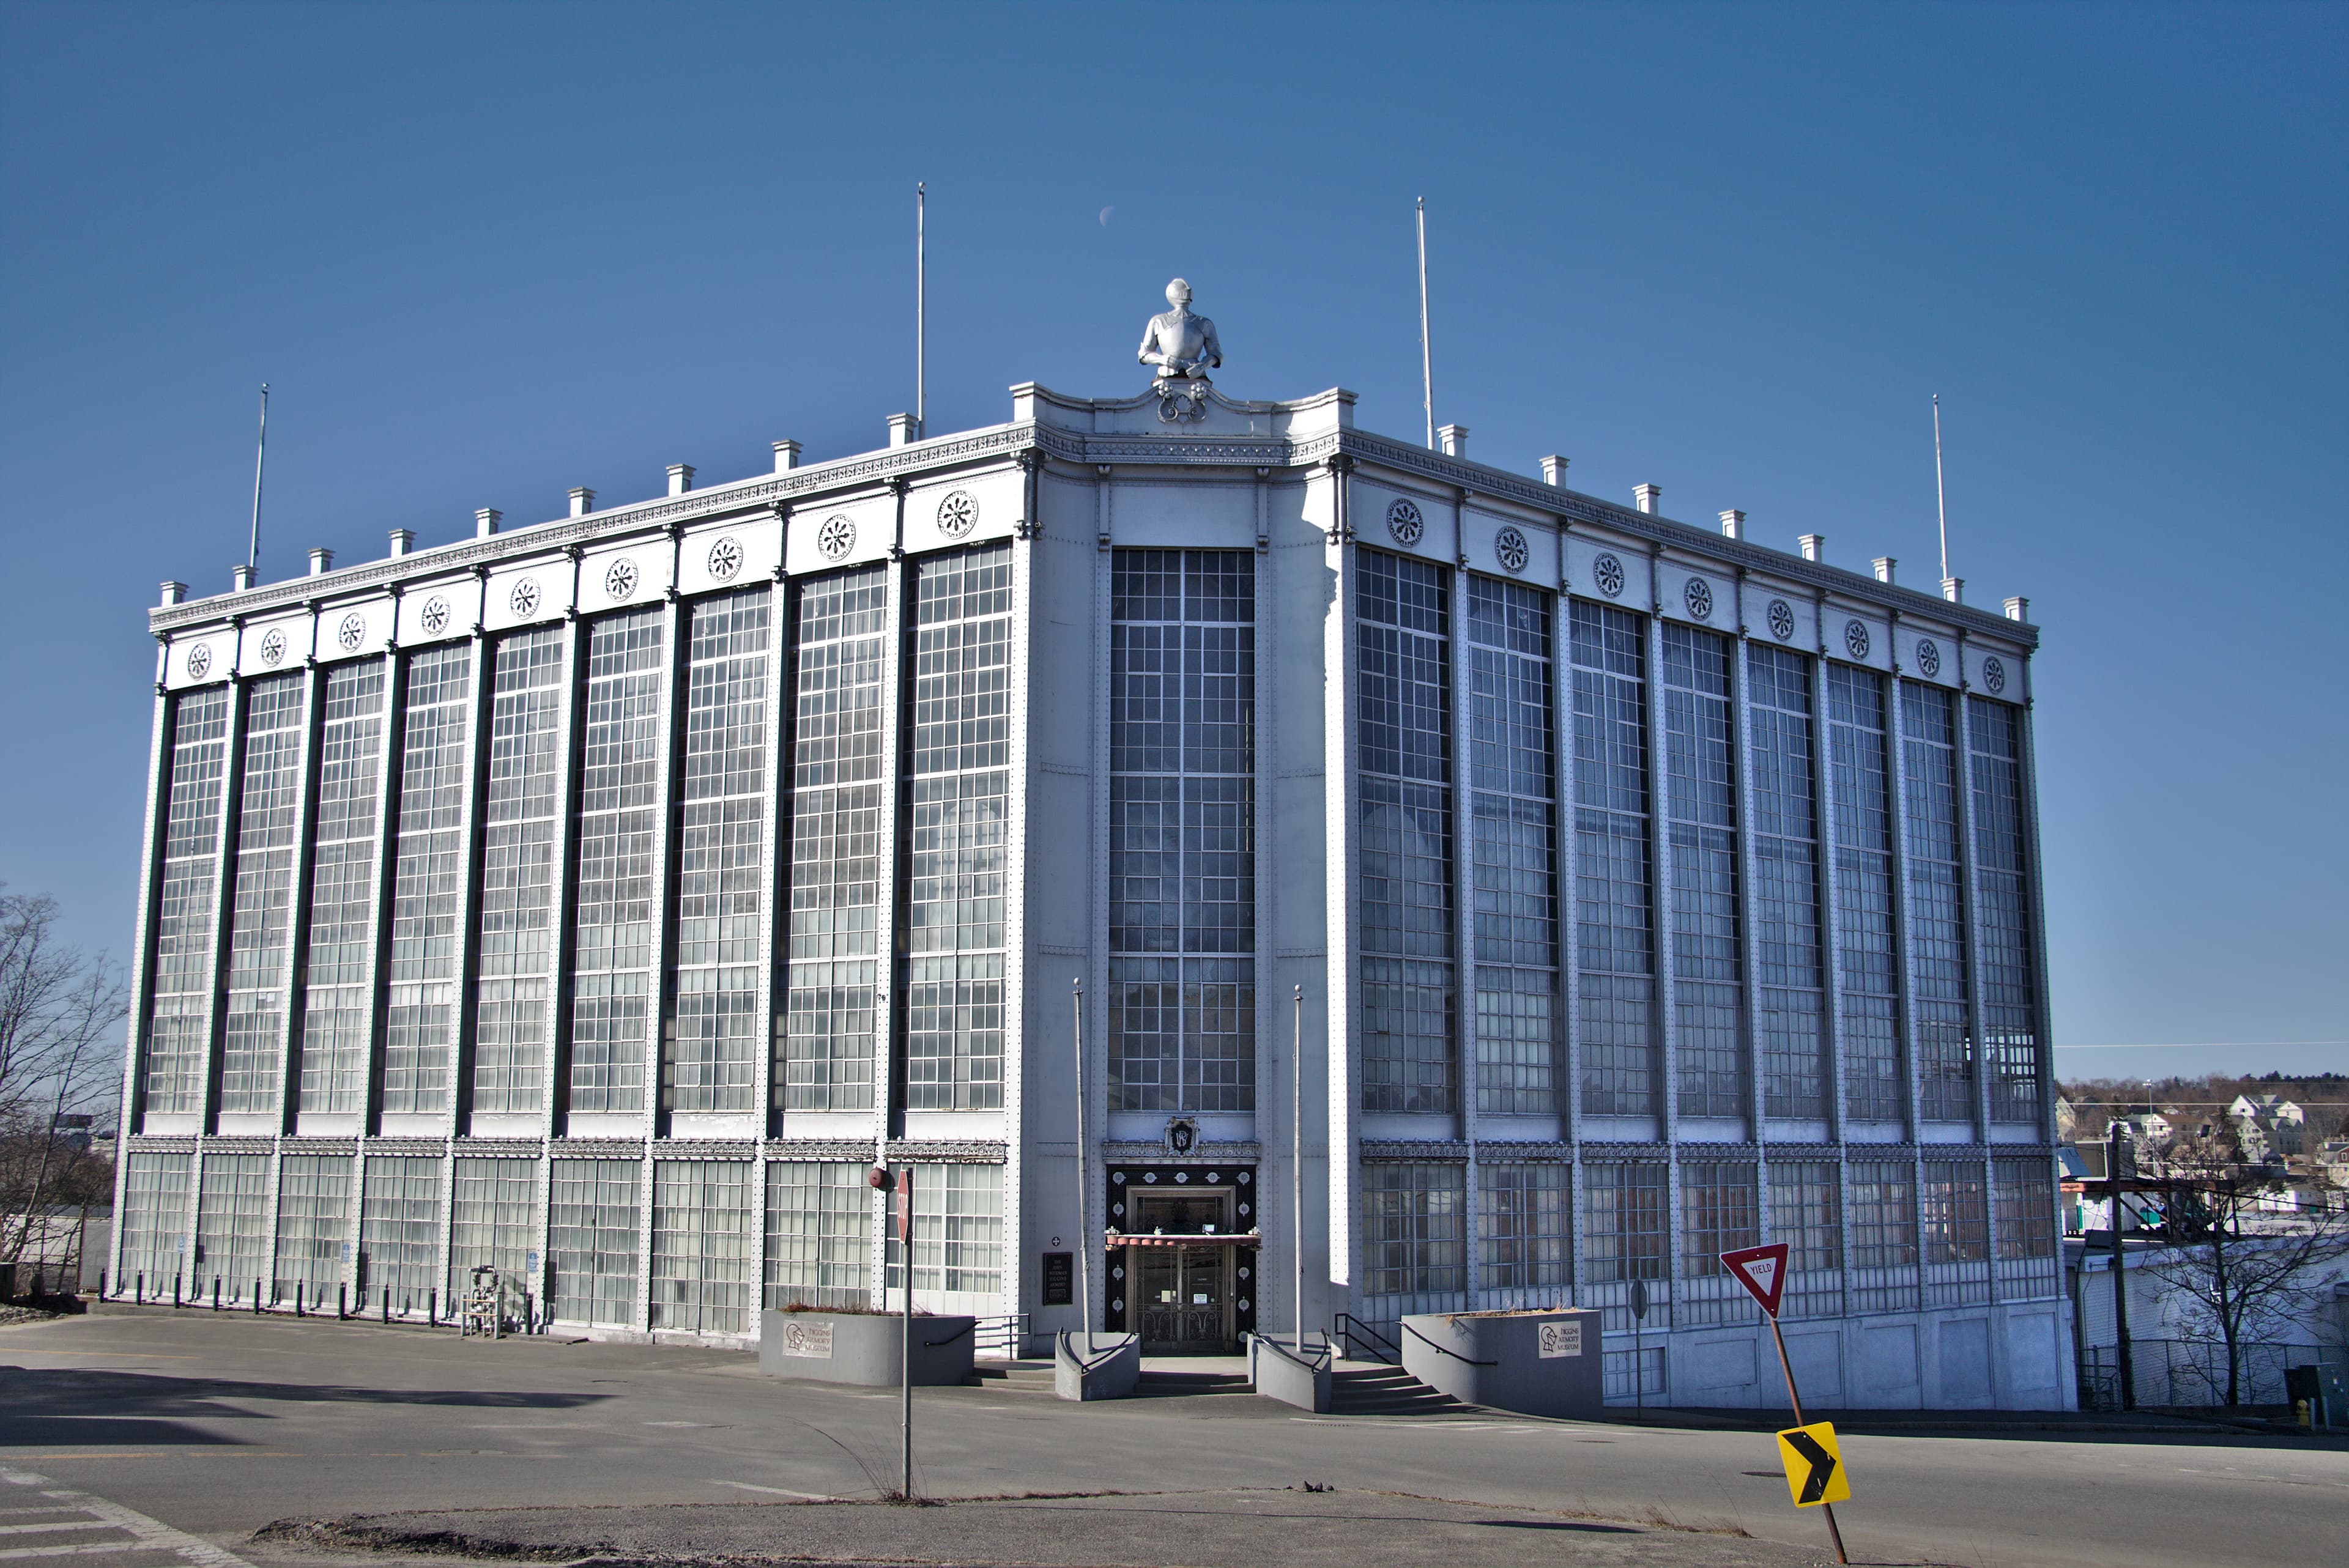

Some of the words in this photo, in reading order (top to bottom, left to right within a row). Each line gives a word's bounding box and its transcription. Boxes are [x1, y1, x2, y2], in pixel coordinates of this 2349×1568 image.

[898, 1193, 908, 1219] STOP
[1750, 1263, 1772, 1274] YIELD
[806, 1337, 830, 1345] ARMORY
